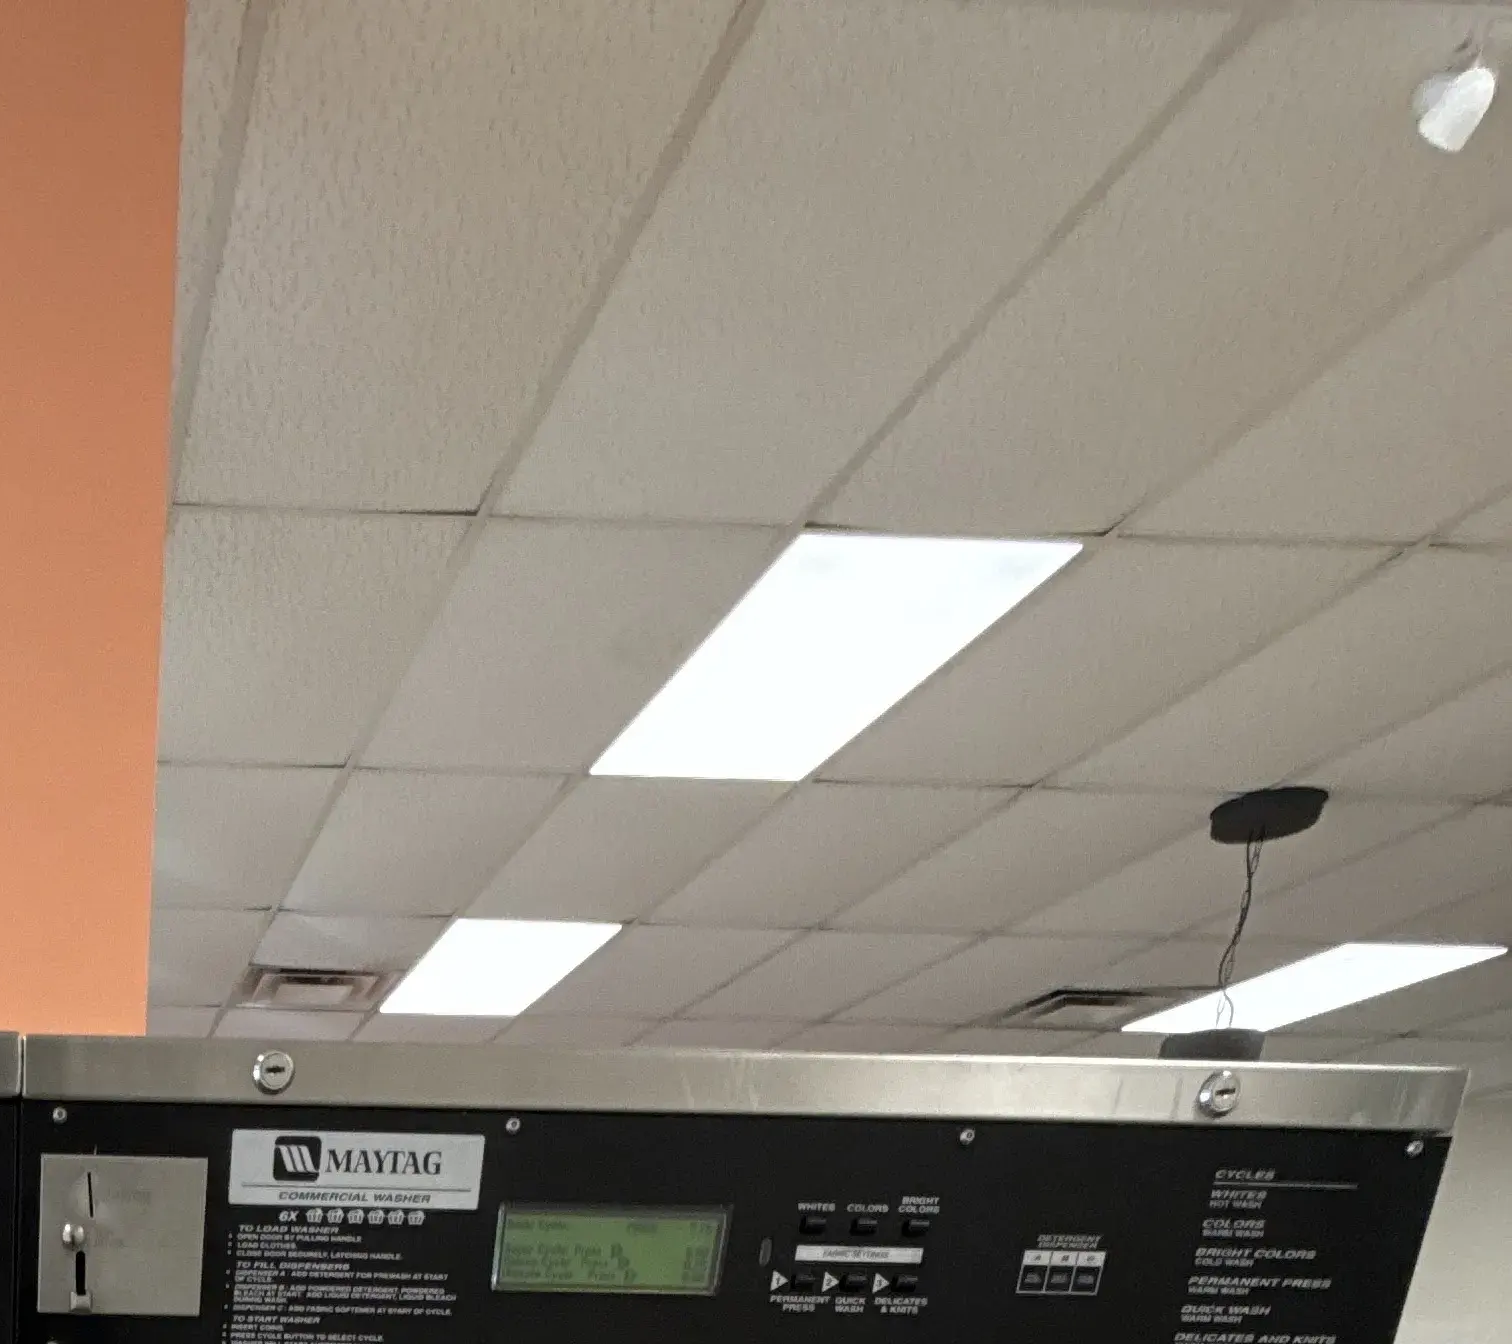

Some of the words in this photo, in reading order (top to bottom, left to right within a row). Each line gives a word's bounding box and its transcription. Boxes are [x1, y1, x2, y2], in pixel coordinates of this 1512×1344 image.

[325, 1149, 442, 1175] MAYTAG
[1215, 1169, 1276, 1181] CYCLES
[278, 1191, 368, 1203] COMMERCIAL
[373, 1193, 431, 1204] WASHER
[1210, 1189, 1268, 1200] WHITES
[902, 1196, 940, 1205] BRIGHT
[1209, 1200, 1230, 1208] HOT
[1233, 1200, 1262, 1209] WASH
[797, 1202, 836, 1213] WHITES
[846, 1203, 889, 1213] COLORS
[898, 1205, 940, 1214] COLORS
[278, 1210, 301, 1222] 6X
[1202, 1219, 1266, 1229] COLORS
[238, 1224, 254, 1232] TO
[256, 1225, 288, 1233] LOAD
[290, 1226, 340, 1234] WASHER
[1235, 1229, 1264, 1238] WASH
[1195, 1247, 1254, 1257] BRIGHT
[1254, 1249, 1317, 1260] COLORS
[237, 1261, 251, 1269] TO
[278, 1262, 350, 1270] DISPENSERS
[1194, 1258, 1223, 1266] COLD
[1225, 1259, 1255, 1267] WASH
[1188, 1276, 1280, 1286] PERMANENT
[1282, 1278, 1332, 1289] PRESS
[1220, 1287, 1251, 1295] WASH
[770, 1295, 831, 1304] PERMANENT
[835, 1297, 865, 1305] QUICK
[874, 1297, 928, 1307] DELICATES
[782, 1303, 815, 1312] PRESS
[835, 1305, 864, 1313] WASH
[889, 1306, 919, 1315] KNITS
[1181, 1304, 1226, 1314] QUICK
[1228, 1305, 1271, 1315] WASH
[280, 1316, 321, 1324] WASHER
[1213, 1315, 1243, 1324] WASH
[1174, 1333, 1255, 1343] DELICATES
[1257, 1335, 1290, 1344] AND
